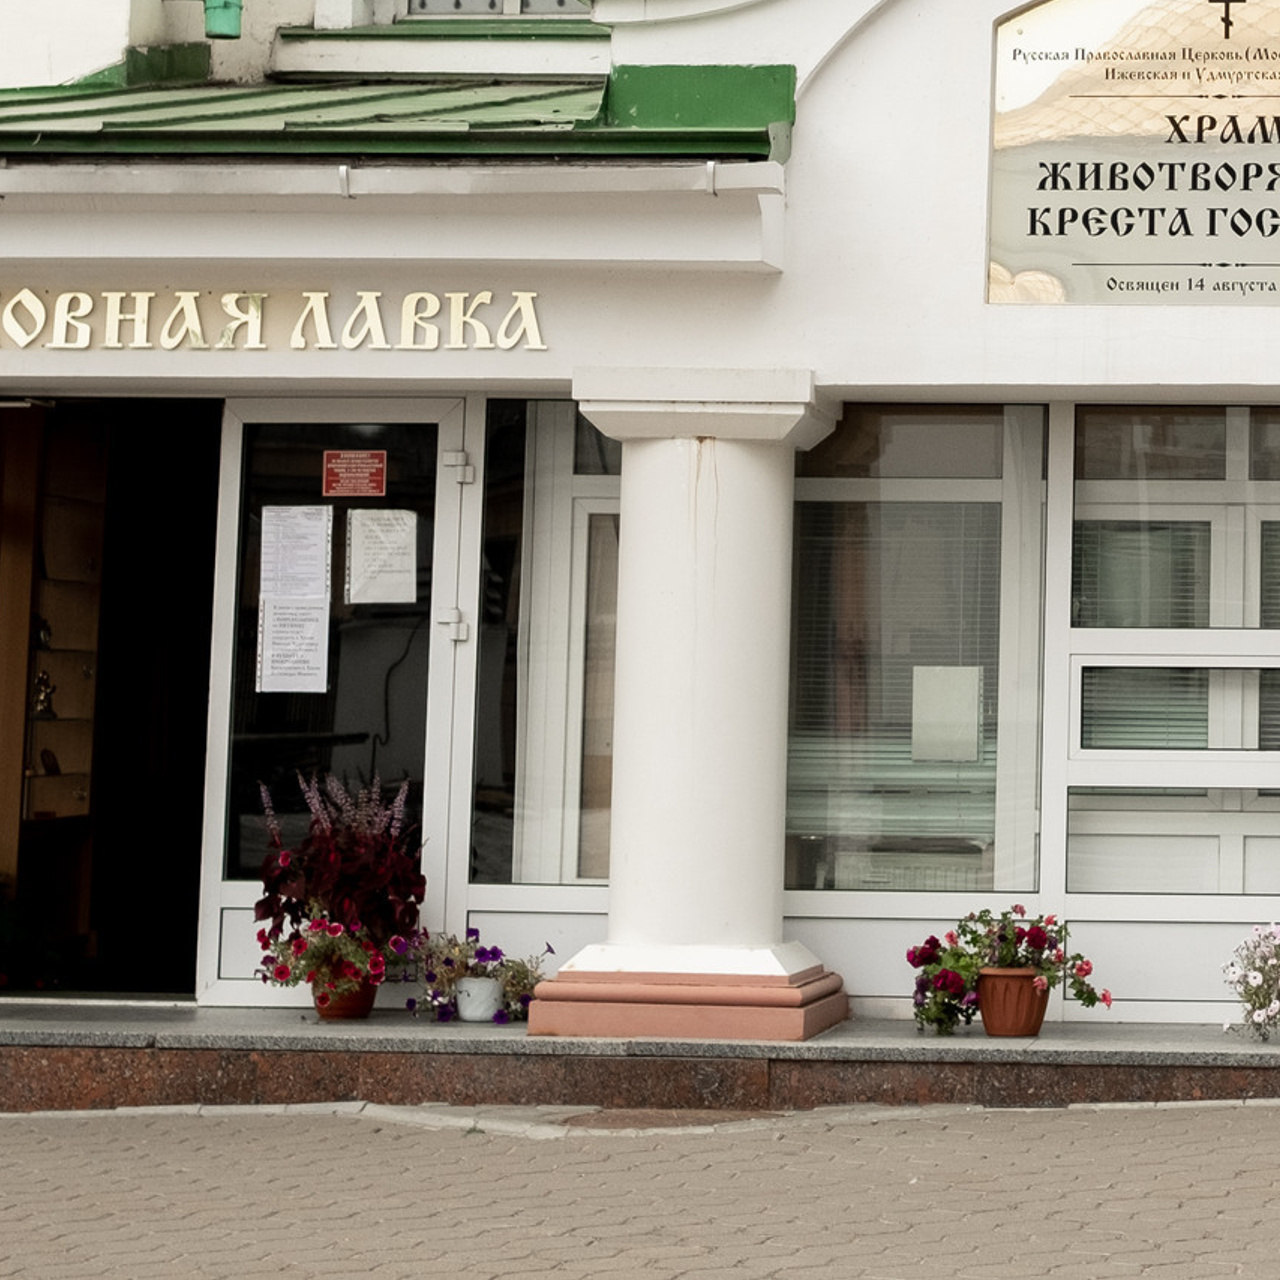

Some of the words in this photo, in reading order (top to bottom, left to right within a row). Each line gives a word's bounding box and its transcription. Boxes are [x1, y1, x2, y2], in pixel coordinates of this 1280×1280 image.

[1012, 47, 1070, 64] Русская
[1074, 47, 1177, 64] Православная
[1181, 47, 1243, 64] Церковь
[1104, 67, 1178, 81] Ижевская
[1181, 71, 1191, 81] и
[1026, 206, 1194, 238] КРЕСТА
[1106, 276, 1180, 294] Освящен
[1186, 277, 1206, 292] 14
[1212, 279, 1278, 297] августа
[1, 287, 269, 350] ОВНАЯ
[289, 290, 548, 350] ЛАВКА
